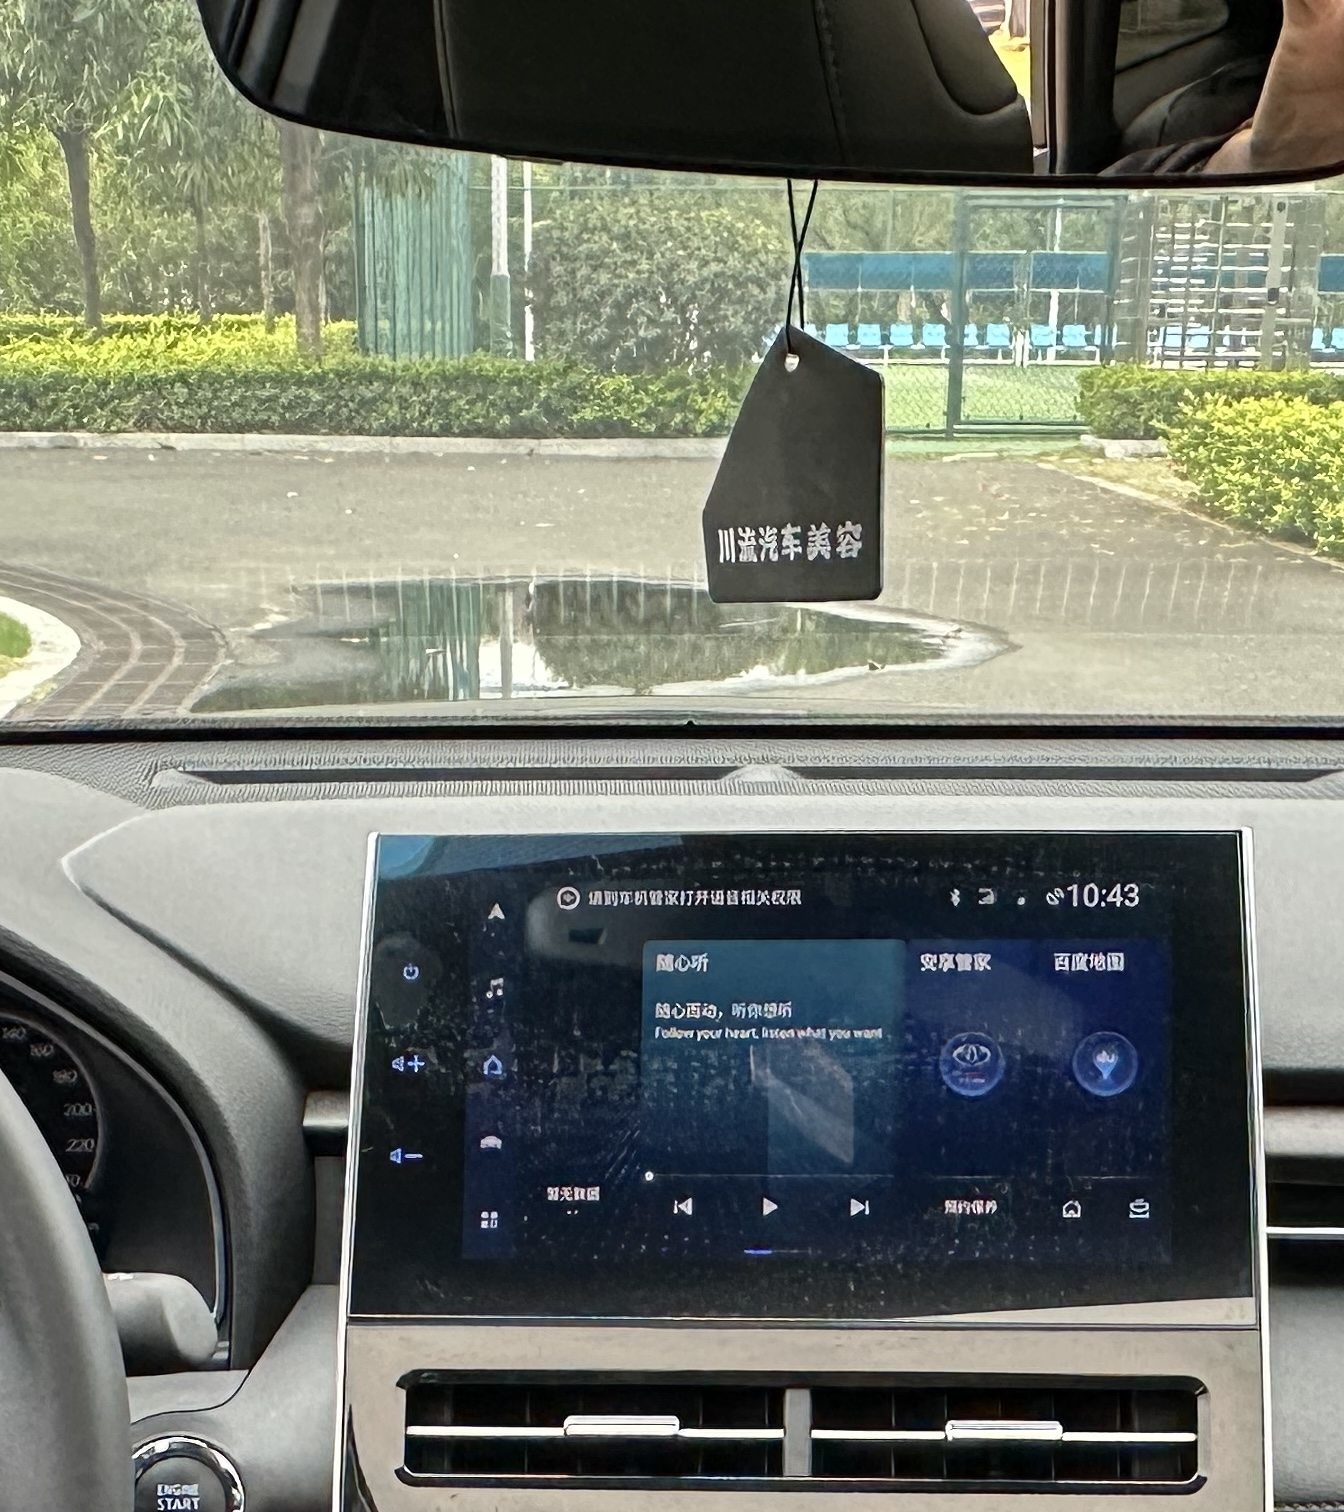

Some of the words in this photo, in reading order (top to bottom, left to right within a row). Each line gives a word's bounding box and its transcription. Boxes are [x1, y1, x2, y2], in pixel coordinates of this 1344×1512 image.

[718, 521, 862, 563] 川流汽车美容
[1067, 883, 1140, 907] 10:43
[656, 952, 709, 973] 随心听
[1054, 952, 1125, 972] 百度地图
[655, 1026, 694, 1039] Follow
[696, 1028, 722, 1041] your
[762, 1026, 794, 1039] listen
[797, 1027, 826, 1039] what
[828, 1029, 851, 1041] you
[853, 1027, 883, 1039] want
[63, 1102, 92, 1116] 200
[64, 1138, 95, 1152] 220
[157, 1498, 200, 1510] START
